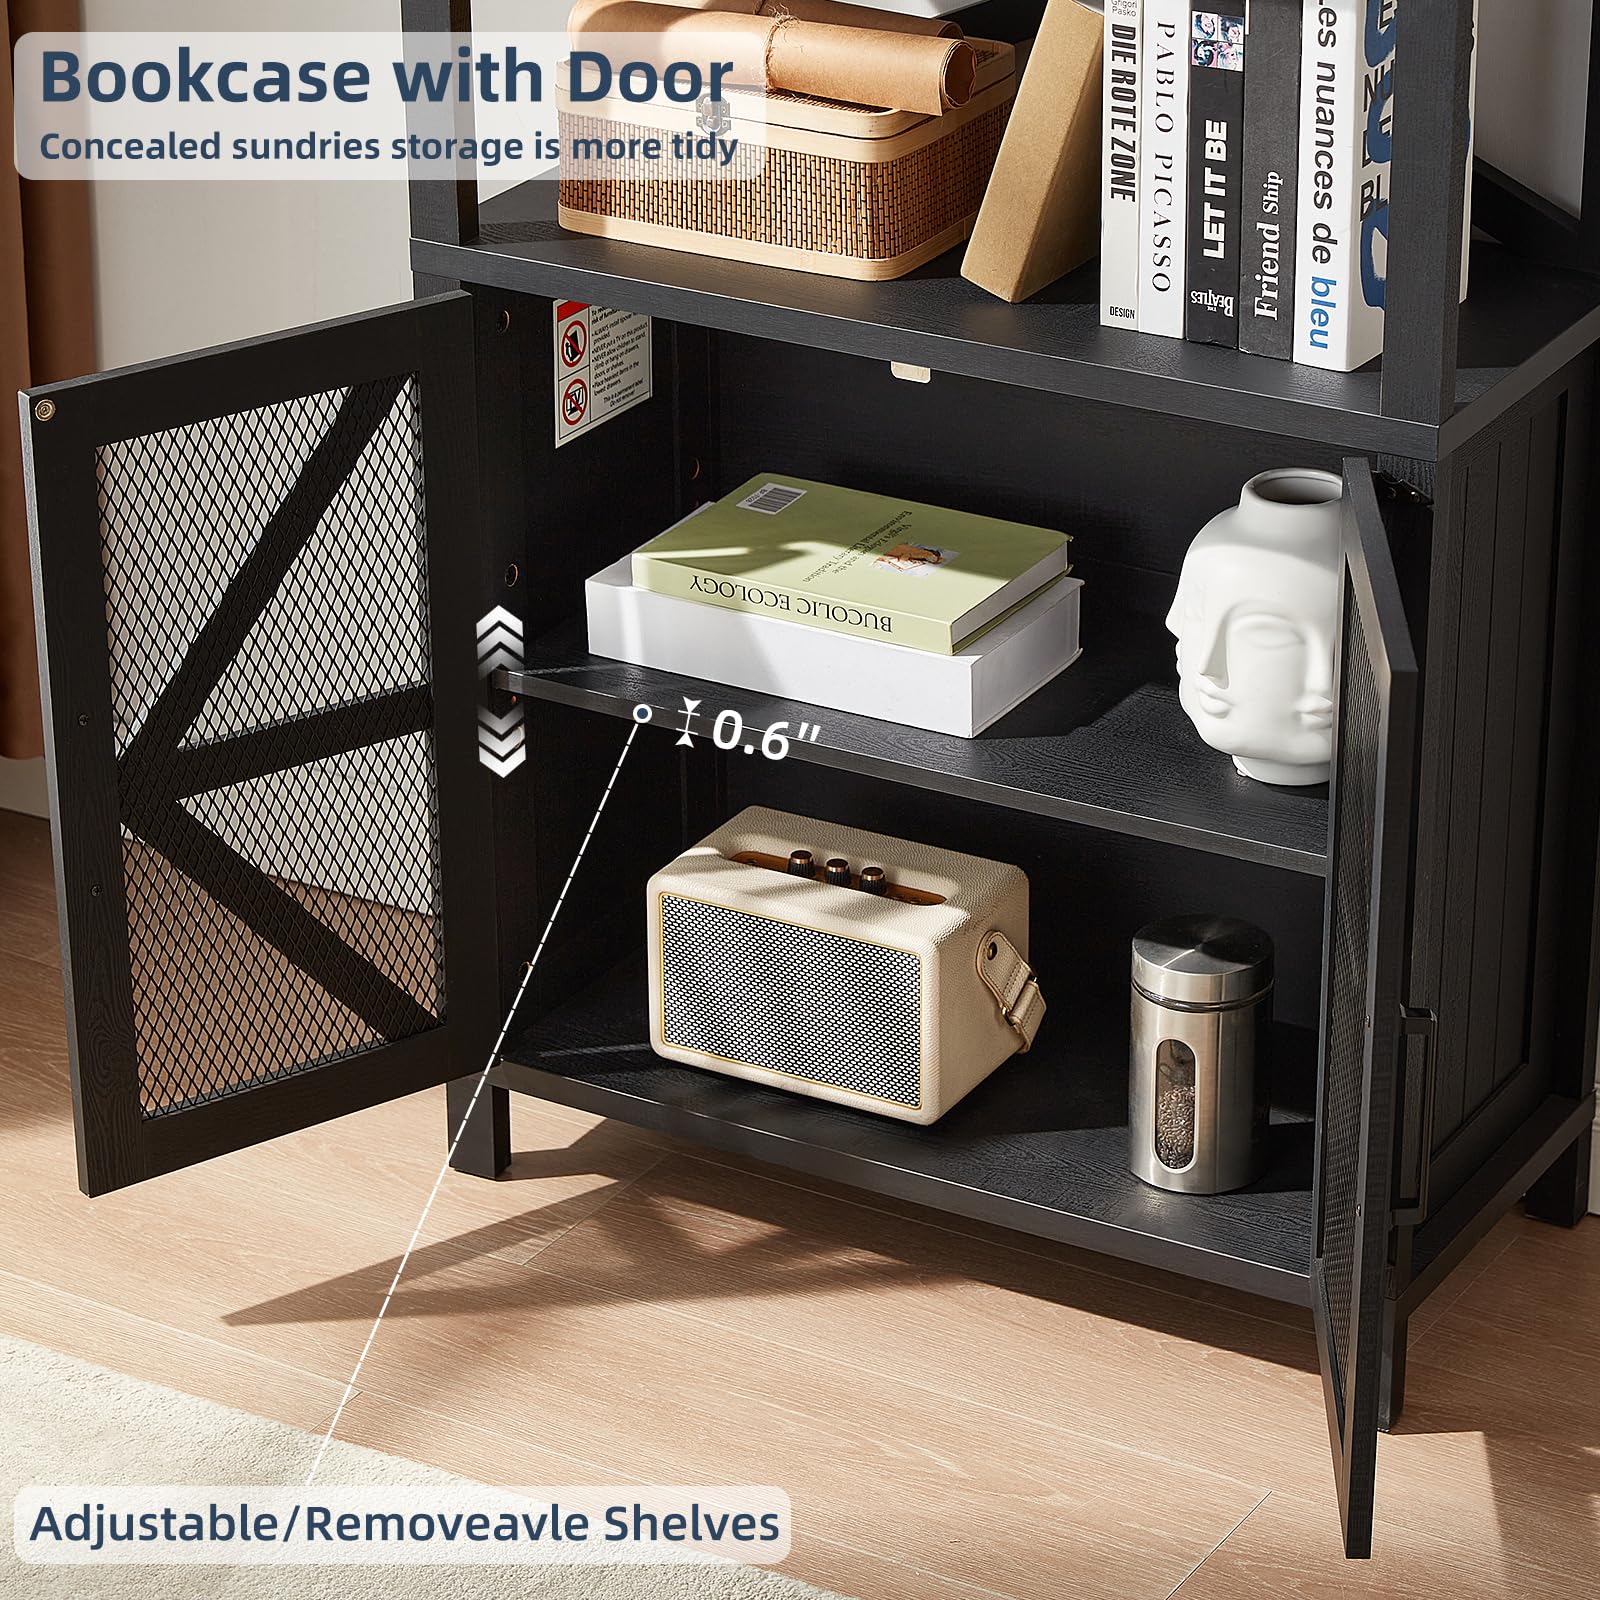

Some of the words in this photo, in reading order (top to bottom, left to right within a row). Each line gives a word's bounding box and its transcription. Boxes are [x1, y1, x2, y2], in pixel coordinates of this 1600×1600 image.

[1111, 6, 1137, 17] Pasko
[1111, 23, 1137, 65] DIE
[1155, 22, 1175, 133] PABLO
[1111, 69, 1137, 133] ROTE
[1204, 119, 1228, 162] BE
[1313, 61, 1336, 210] nuances
[1110, 136, 1136, 203] ZONE
[1204, 166, 1227, 197] IT
[1262, 171, 1284, 215] Ship
[1151, 152, 1173, 292] PICASSO
[1203, 201, 1226, 259] LET
[1311, 222, 1338, 264] de
[1254, 221, 1281, 321] Friend
[1109, 305, 1135, 320] DESIGN
[1190, 289, 1235, 318] BEATLES
[1309, 275, 1337, 350] bleu
[593, 343, 605, 353] NEVER
[593, 352, 606, 361] NEVER
[801, 559, 839, 583] Tradition
[689, 574, 791, 611] ECOLOGY
[796, 597, 893, 633] BUCOLIC
